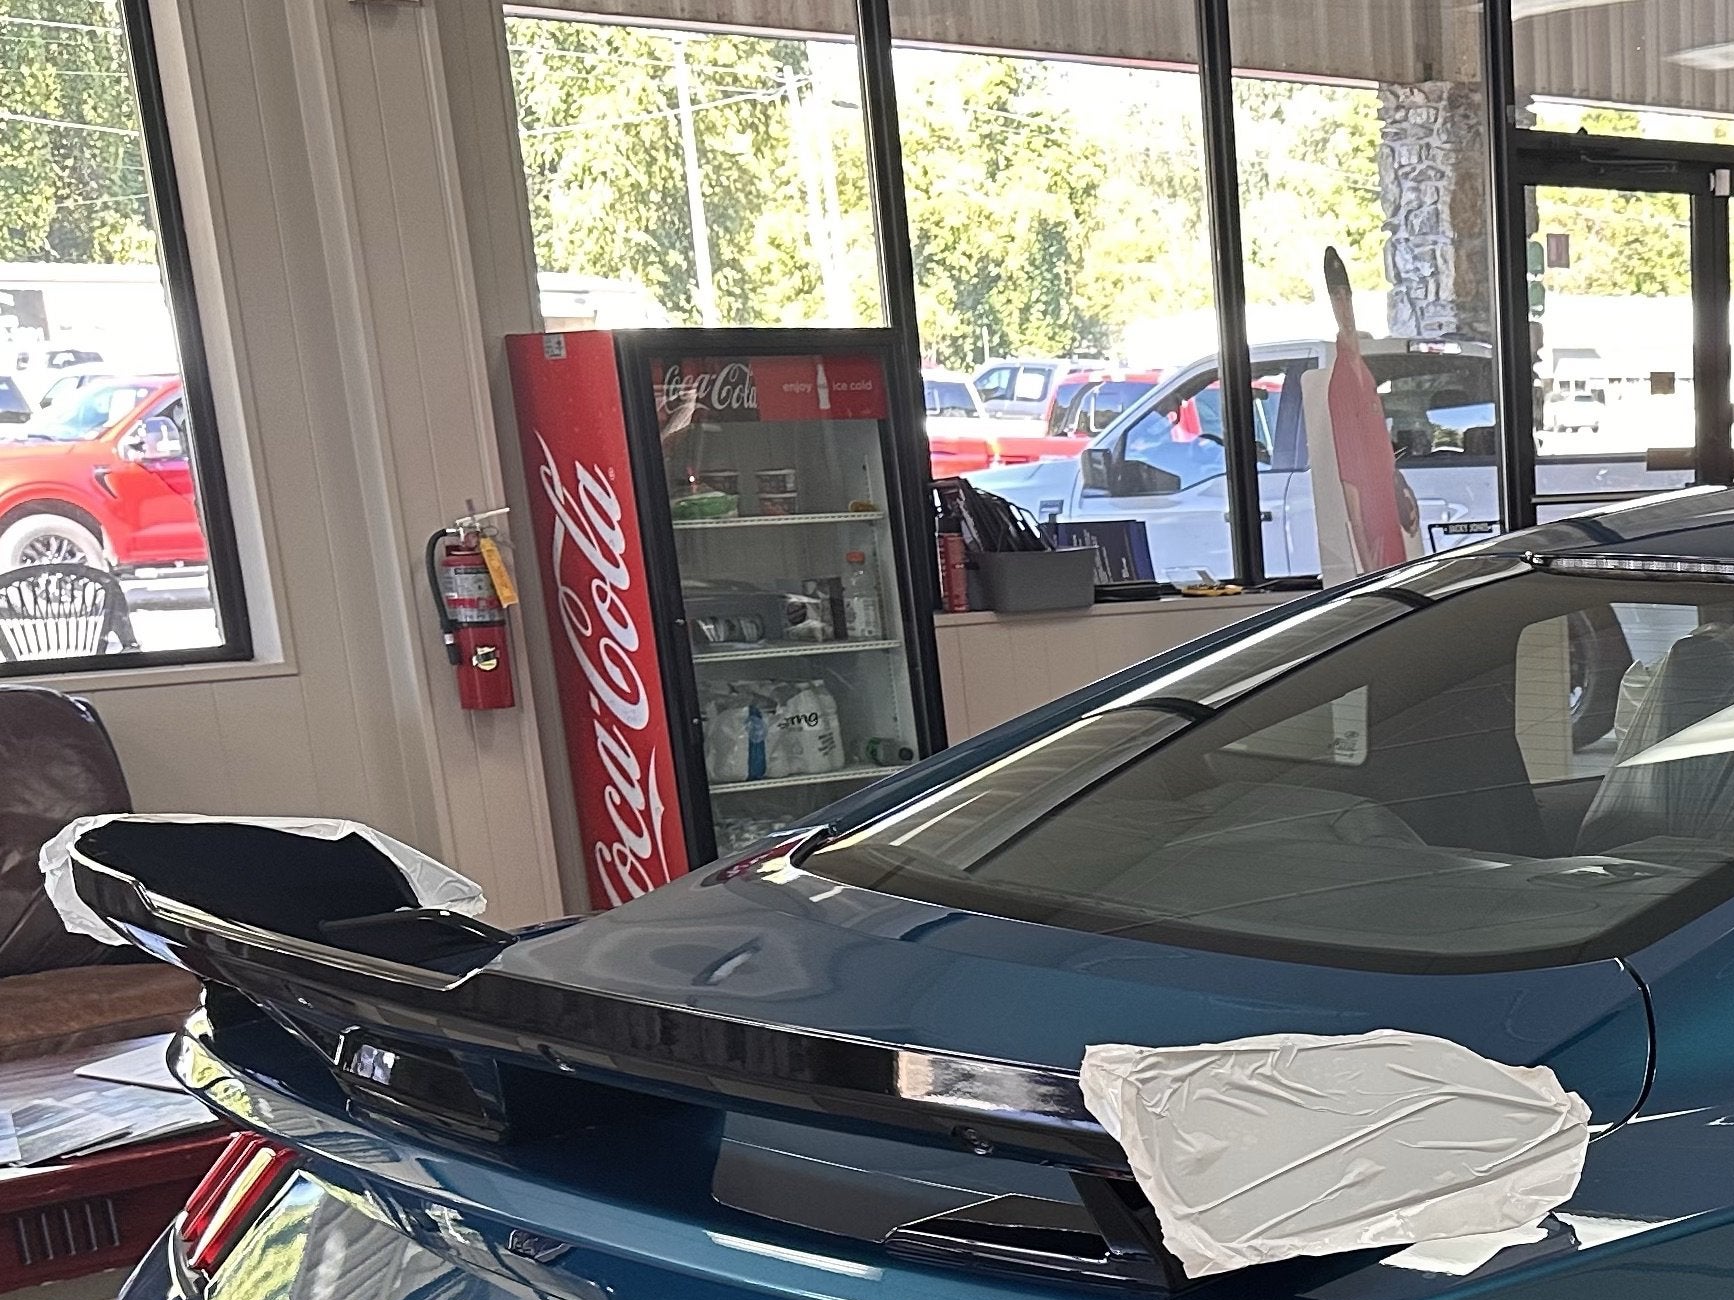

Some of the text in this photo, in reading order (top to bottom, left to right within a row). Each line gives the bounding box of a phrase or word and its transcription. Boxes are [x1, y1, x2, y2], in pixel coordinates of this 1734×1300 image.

[782, 382, 814, 394] enjoy
[849, 380, 873, 391] cold
[535, 430, 668, 907] Coca-Cola
